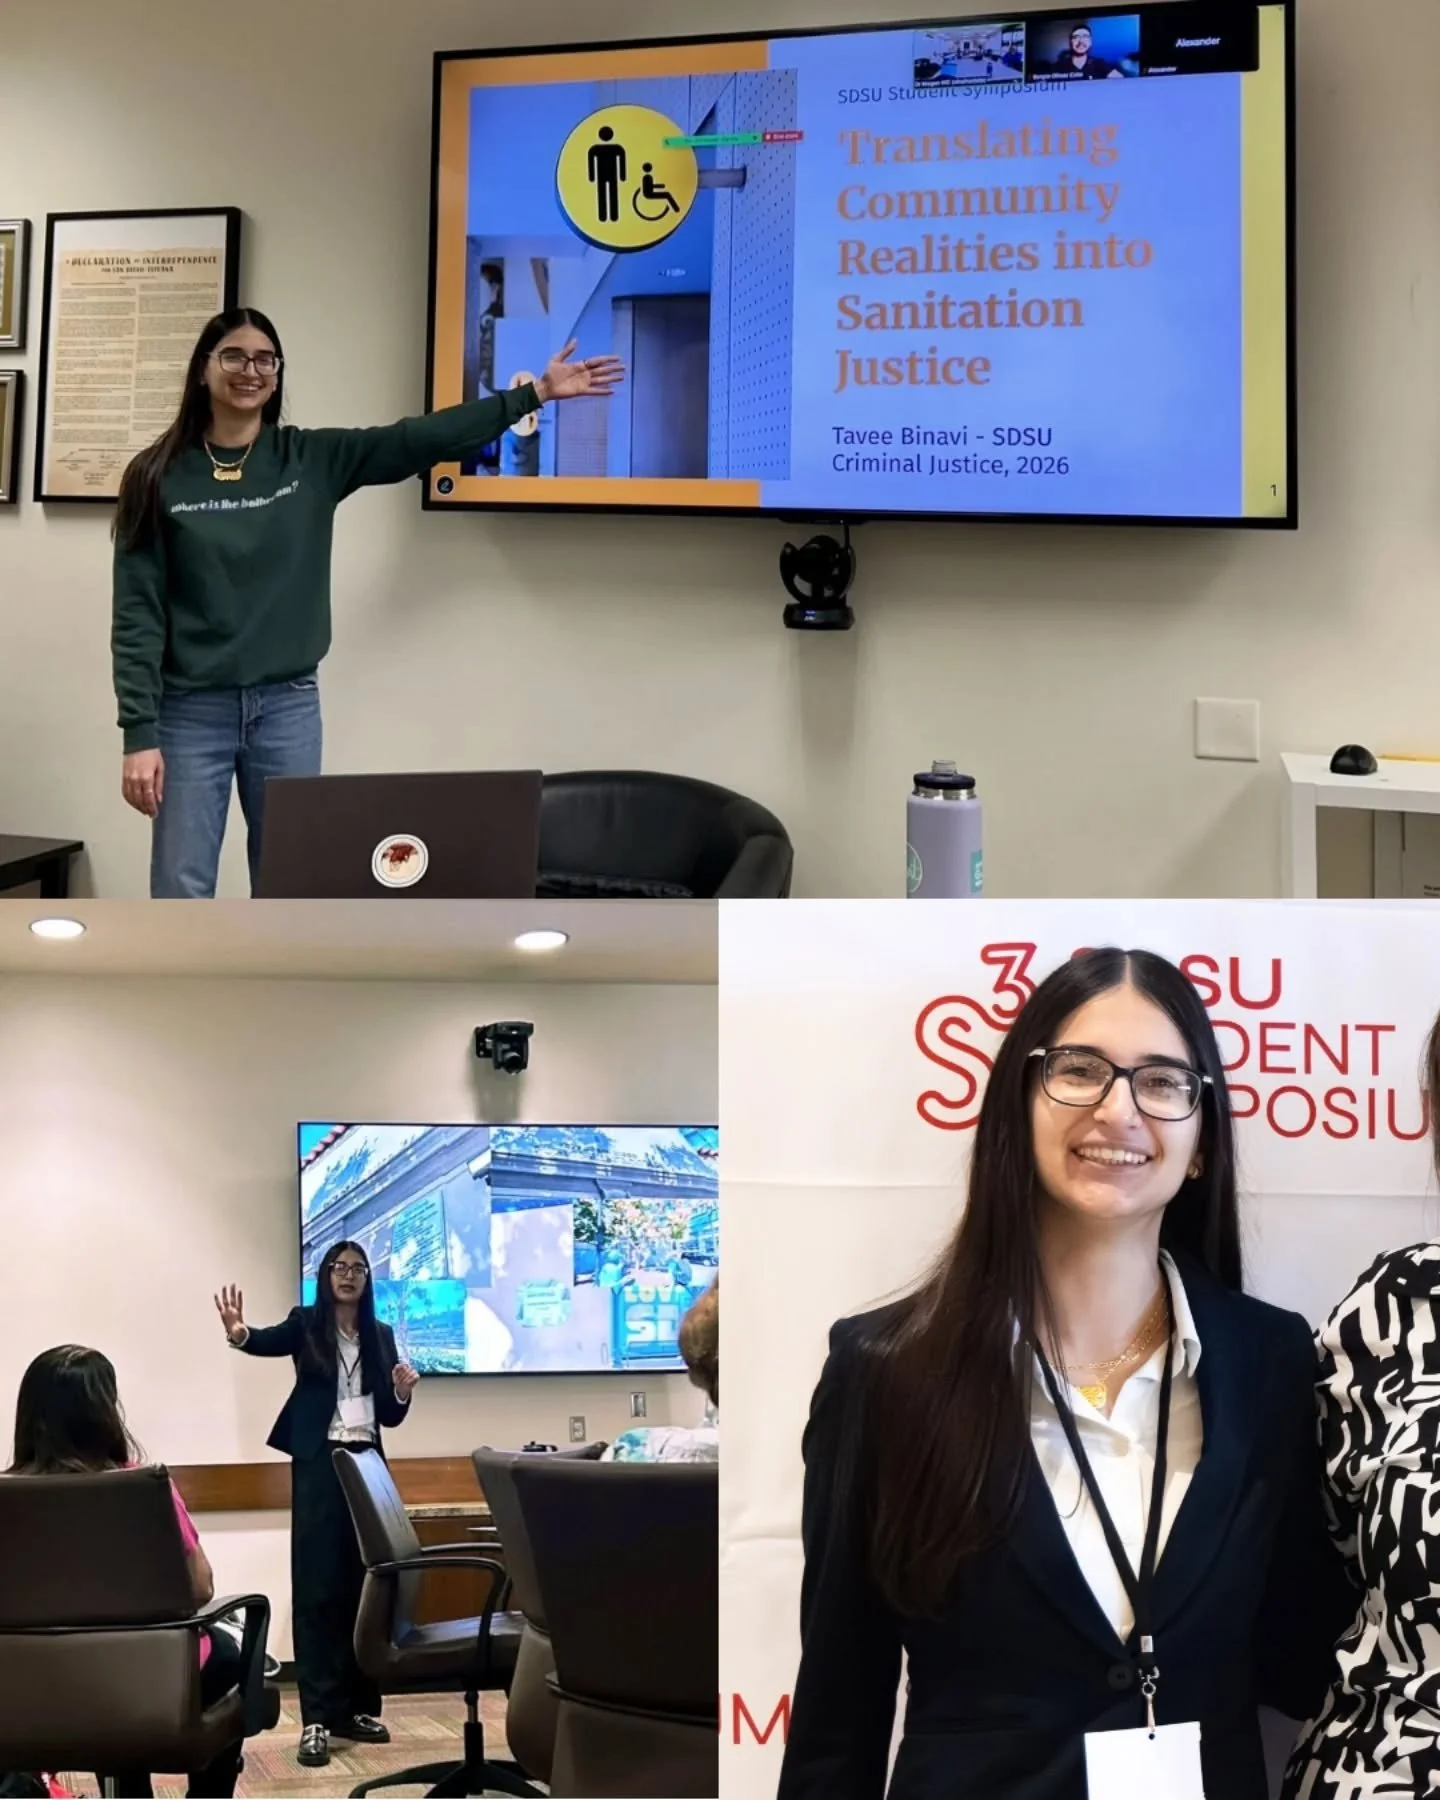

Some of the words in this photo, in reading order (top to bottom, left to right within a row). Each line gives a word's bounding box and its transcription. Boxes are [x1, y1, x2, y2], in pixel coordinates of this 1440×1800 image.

[1176, 36, 1221, 47] Alexander
[837, 86, 883, 104] SDSU
[888, 83, 957, 102] Student
[962, 79, 1067, 100] Symposium
[838, 117, 1120, 167] Translating
[837, 173, 1120, 222] Community
[837, 233, 1040, 276] Realities
[1053, 229, 1153, 270] into
[837, 288, 1084, 331] Sanitation
[834, 346, 991, 394] Justice
[832, 426, 893, 445] Tavee
[902, 425, 968, 446] Binavi
[992, 427, 1052, 447] SDSU
[832, 453, 922, 473] Criminal
[929, 454, 1009, 478] Justice,
[1017, 456, 1069, 475] 2026
[1270, 484, 1277, 497] 1
[1210, 1020, 1396, 1076] DENT
[1228, 1084, 1431, 1140] POSIU
